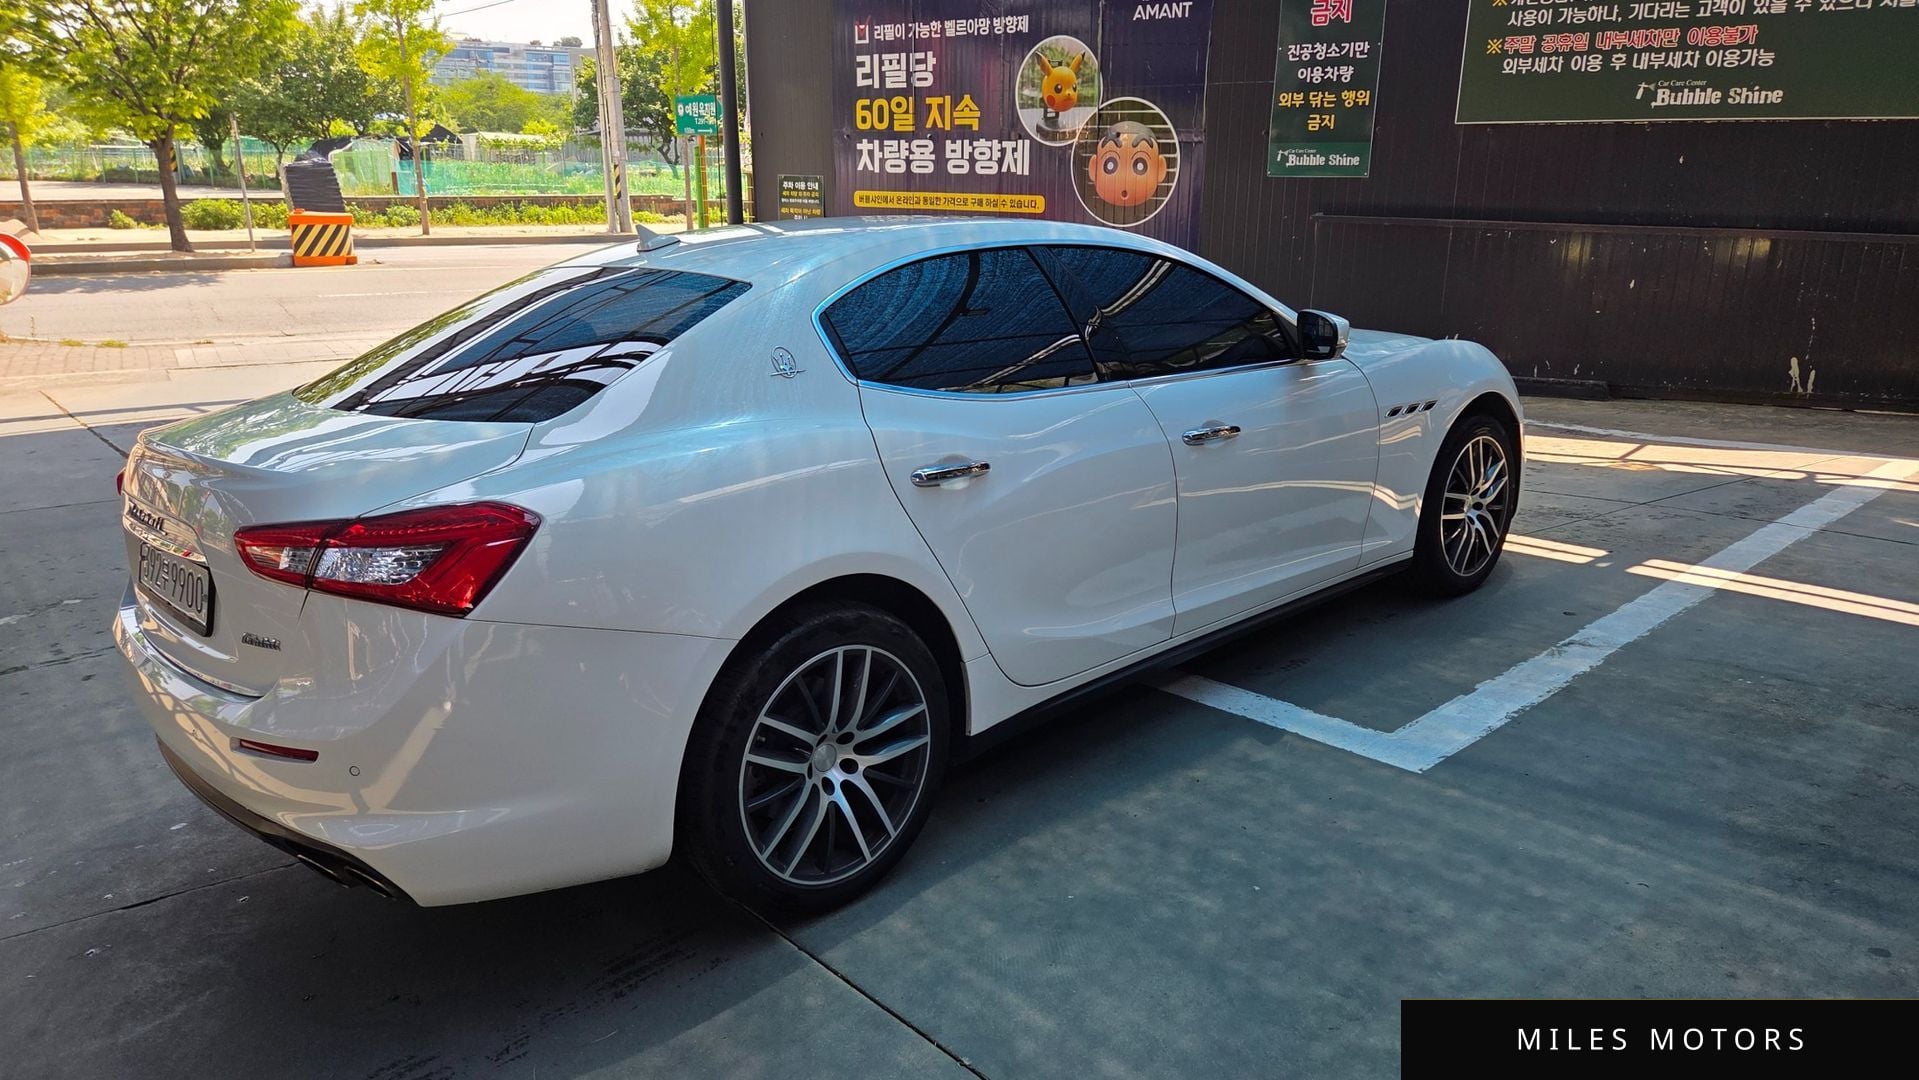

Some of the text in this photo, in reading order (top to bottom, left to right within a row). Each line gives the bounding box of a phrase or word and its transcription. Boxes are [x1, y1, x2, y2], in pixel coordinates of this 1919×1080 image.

[1133, 2, 1193, 20] AMANT
[1311, 0, 1352, 26] 금지
[1507, 8, 1552, 27] 사용이
[1557, 4, 1622, 24] 가능하나,
[1628, 2, 1691, 20] 기다리는
[1696, 0, 1746, 17] 고객이
[874, 15, 1029, 41] 리필이 가능한 벨르아망 방향제
[1541, 32, 1590, 53] 공휴일
[1595, 27, 1681, 51] 내부세차만
[1687, 25, 1759, 47] 이용불가
[1287, 41, 1370, 61] 진공청소기만
[1502, 48, 1775, 75] 외부세차 이용 후 내부세차 이용가능
[856, 51, 936, 88] 리필당
[1298, 65, 1354, 83] 이용차량
[1278, 90, 1370, 108] 외부 닦는 행위
[1651, 85, 1783, 108] Bubble Shine
[856, 94, 981, 131] 60일 지속
[1307, 114, 1335, 131] 금지
[856, 139, 1030, 175] 차량용 방향제
[1286, 153, 1360, 167] Bubble Shine
[1000, 198, 1007, 208] 수
[1009, 198, 1040, 209] 있습니다.
